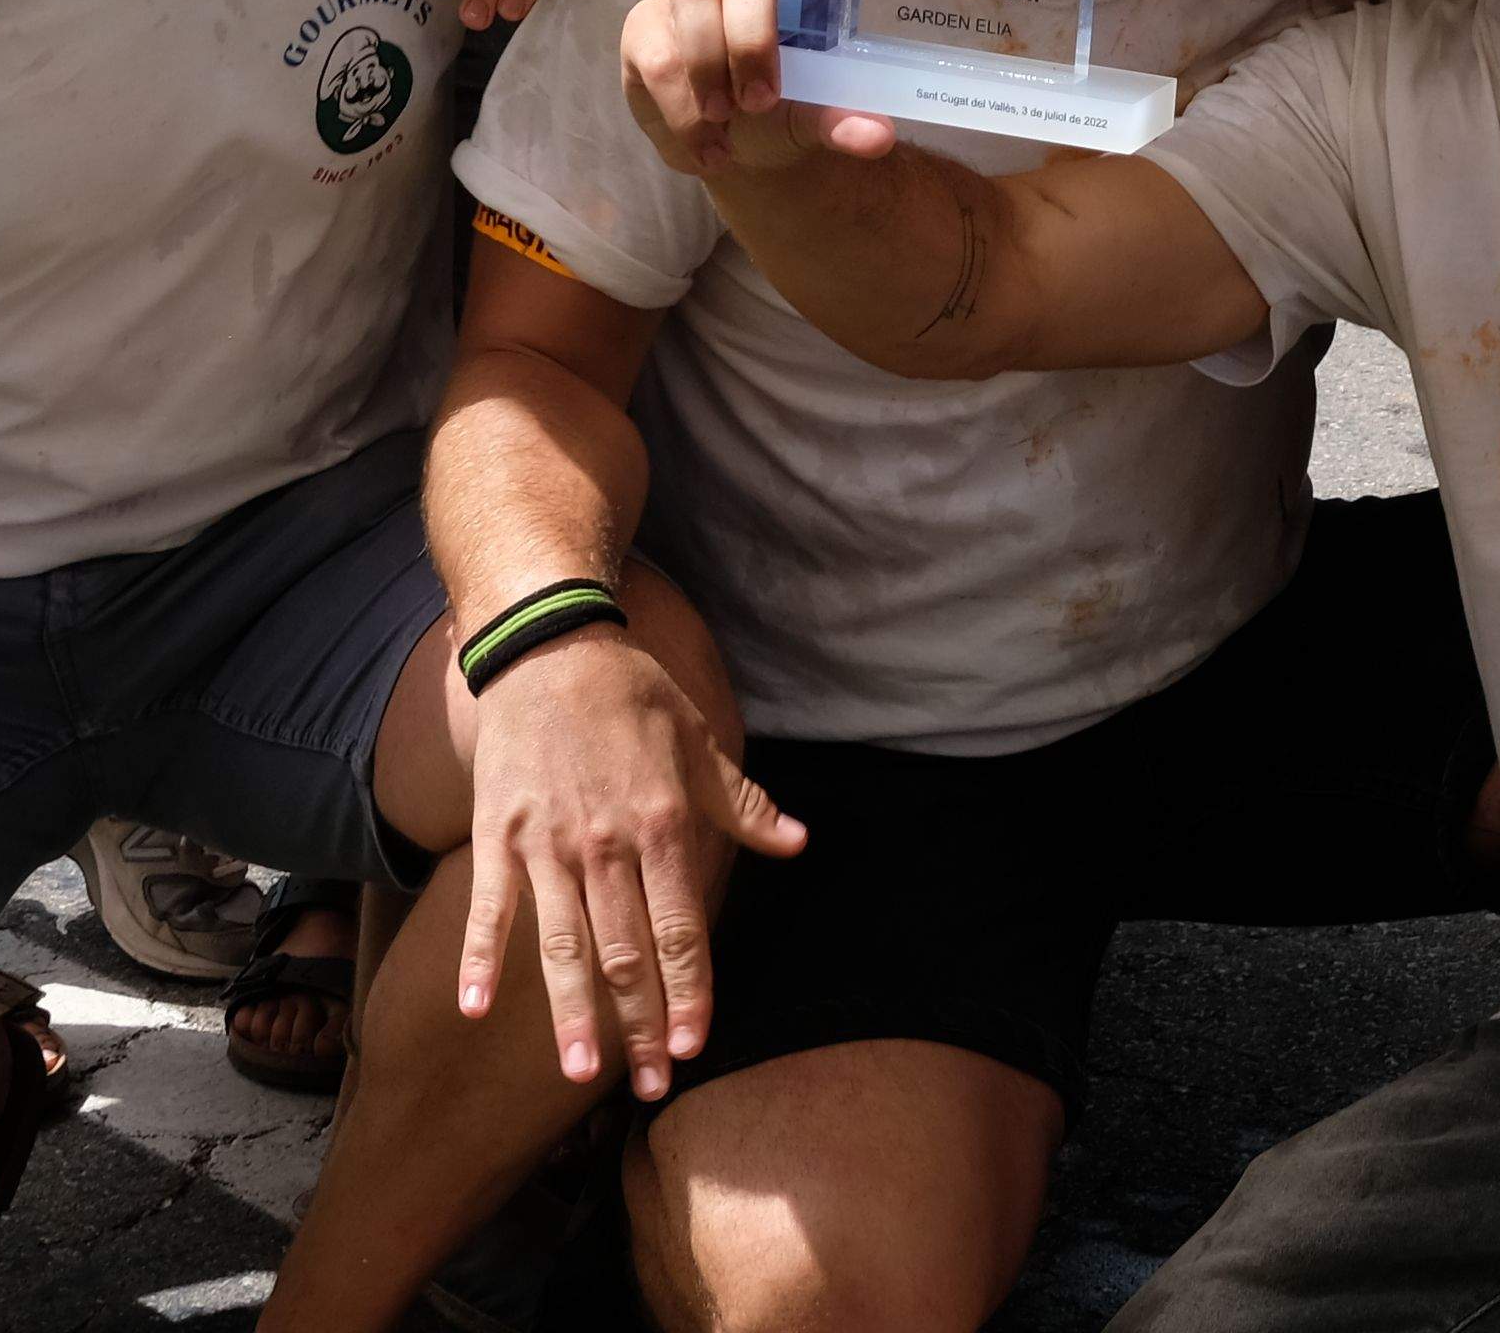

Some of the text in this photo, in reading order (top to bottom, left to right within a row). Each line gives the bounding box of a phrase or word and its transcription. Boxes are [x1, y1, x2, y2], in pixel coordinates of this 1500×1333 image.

[897, 5, 1013, 38] GARDEN ELIA
[916, 88, 939, 101] Sant
[940, 91, 969, 107] Cugat
[970, 97, 986, 109] del
[1029, 106, 1042, 118] de
[1043, 107, 1067, 123] juliol
[1068, 112, 1082, 125] de
[1083, 115, 1108, 129] 2022
